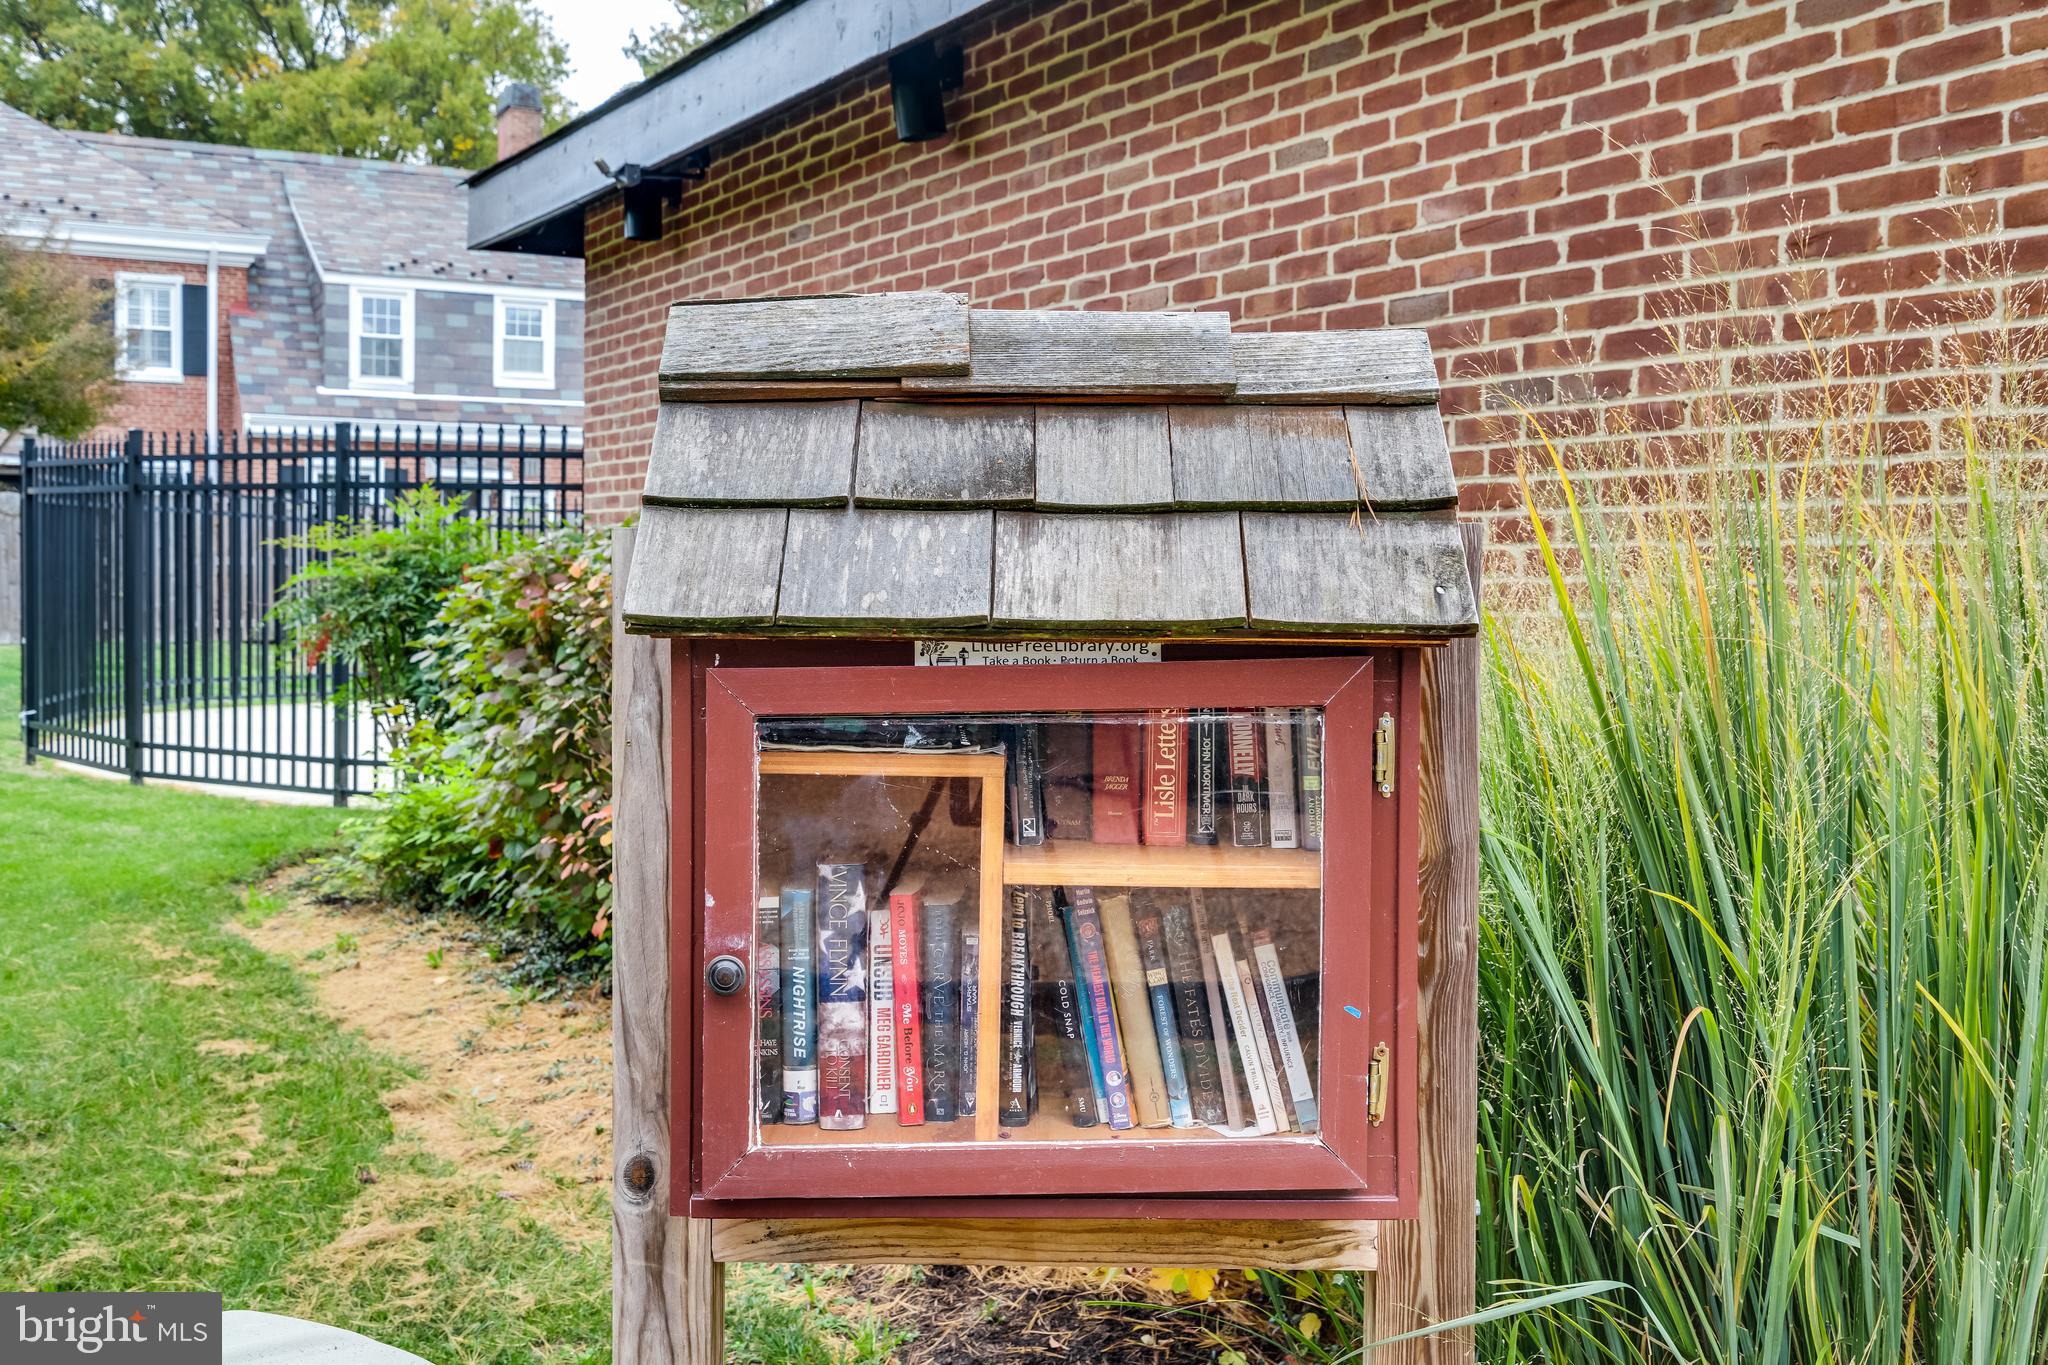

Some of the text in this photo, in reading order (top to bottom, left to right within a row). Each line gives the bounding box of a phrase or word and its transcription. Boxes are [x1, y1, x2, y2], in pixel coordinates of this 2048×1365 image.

[971, 641, 1150, 655] LittleFreeLibrary.org
[982, 656, 1010, 666] Take
[1013, 658, 1020, 666] a
[1023, 656, 1051, 666] Book
[1060, 656, 1098, 666] Return
[1101, 657, 1108, 665] a
[1155, 708, 1177, 770] Lettes
[1306, 734, 1320, 772] EVIL
[1104, 775, 1129, 783] BRENDA
[1154, 774, 1176, 819] Lisle
[1201, 737, 1212, 814] JOHN MORTIMER
[1237, 792, 1254, 802] DARK
[1236, 804, 1257, 814] HOURS
[1308, 796, 1316, 836] ANTHONY
[828, 870, 848, 997] VINCE FLYNN
[896, 900, 908, 965] JOJO MOYES
[874, 944, 892, 1000] UNSUB
[1088, 950, 1098, 964] THE
[1010, 890, 1030, 1093] Zero to BREAKTHROUGH VERNICE ARMOUR
[1090, 966, 1102, 996] MEANEST
[1266, 960, 1290, 1030] Communicate
[793, 966, 806, 1058] NIGHTRISE
[930, 948, 952, 1093] CARVE THE MARK
[1058, 980, 1075, 1040] COLD SNAP
[1096, 998, 1107, 1014] DOLL
[1178, 951, 1213, 1102] THE FATES DIVIDE
[1230, 991, 1240, 1010] Next
[1236, 1010, 1247, 1038] Decider
[876, 1008, 891, 1091] MEG GARDINER
[902, 1004, 918, 1092] Me Before You
[1100, 1024, 1111, 1036] THE
[1102, 1038, 1115, 1064] WORLD
[1158, 994, 1167, 1025] FOREST
[1164, 1038, 1177, 1080] WONDERS
[839, 1039, 850, 1099] CONSENT
[1244, 1045, 1260, 1090] CALVIN TRILLIN
[1281, 1039, 1294, 1069] INFLUENCE
[826, 1066, 838, 1092] KILL
[1078, 1097, 1087, 1112] SMU
